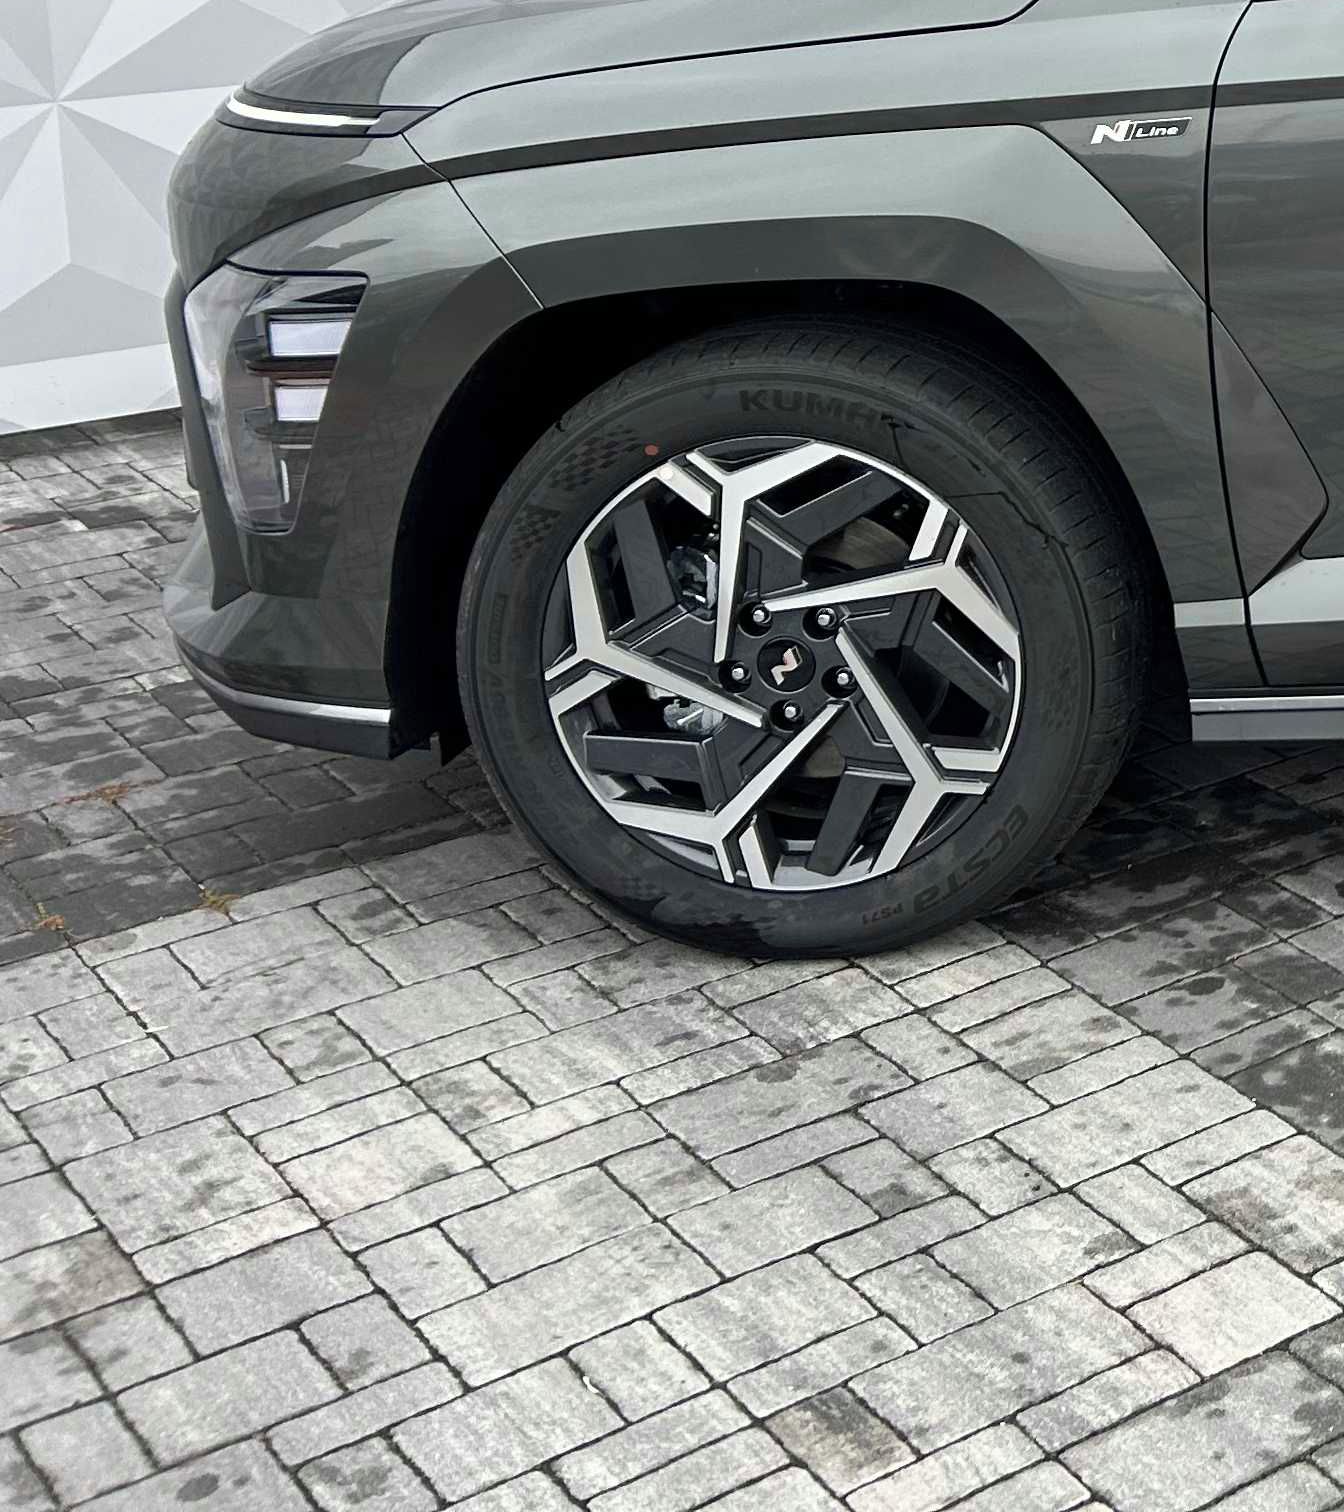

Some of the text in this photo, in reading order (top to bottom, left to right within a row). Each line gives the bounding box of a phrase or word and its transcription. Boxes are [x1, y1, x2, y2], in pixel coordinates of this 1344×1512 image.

[1091, 119, 1180, 145] N Line
[861, 902, 903, 925] PS71
